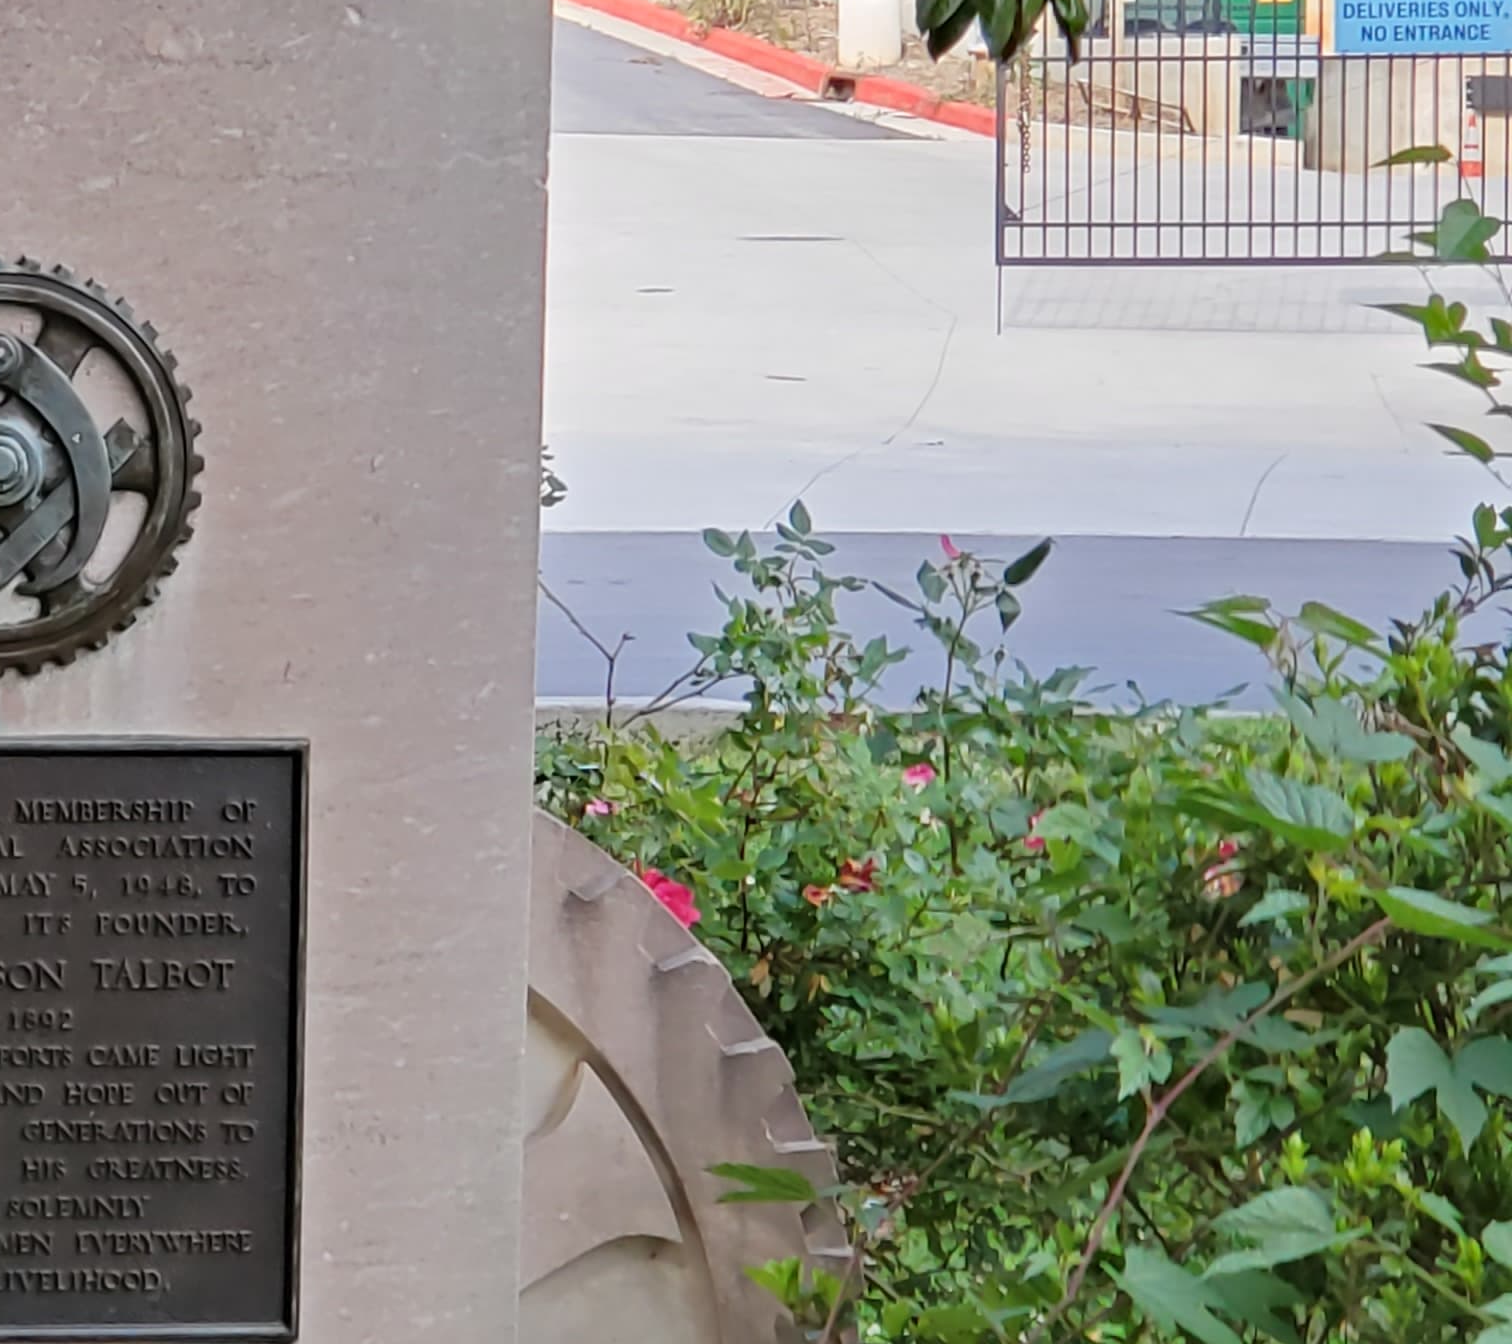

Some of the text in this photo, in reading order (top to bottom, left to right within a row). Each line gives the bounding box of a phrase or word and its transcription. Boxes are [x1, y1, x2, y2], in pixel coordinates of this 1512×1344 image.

[1343, 1, 1509, 19] DELIVERIES ONLY.
[1361, 24, 1491, 42] NO ENTRANCE
[14, 799, 193, 824] MEMBERSHIP
[222, 799, 256, 824] OF
[60, 836, 254, 860] ASSOCIATION
[219, 873, 256, 898] TO
[23, 912, 71, 937] ITS
[95, 912, 249, 937] FOUNDER,
[92, 959, 235, 992] TALBOT
[7, 1007, 73, 1032] 1892
[88, 1046, 160, 1070] CAME
[176, 1046, 255, 1070] LIGHT
[64, 1083, 134, 1106] HOPE
[155, 1083, 208, 1106] OUT
[222, 1083, 254, 1106] OF
[21, 1121, 207, 1145] GENERATIONS
[219, 1121, 255, 1145] TO
[21, 1159, 67, 1183] HIS
[6, 1196, 148, 1220] SOLEMNLY
[76, 1231, 253, 1256] EVERYWHERE
